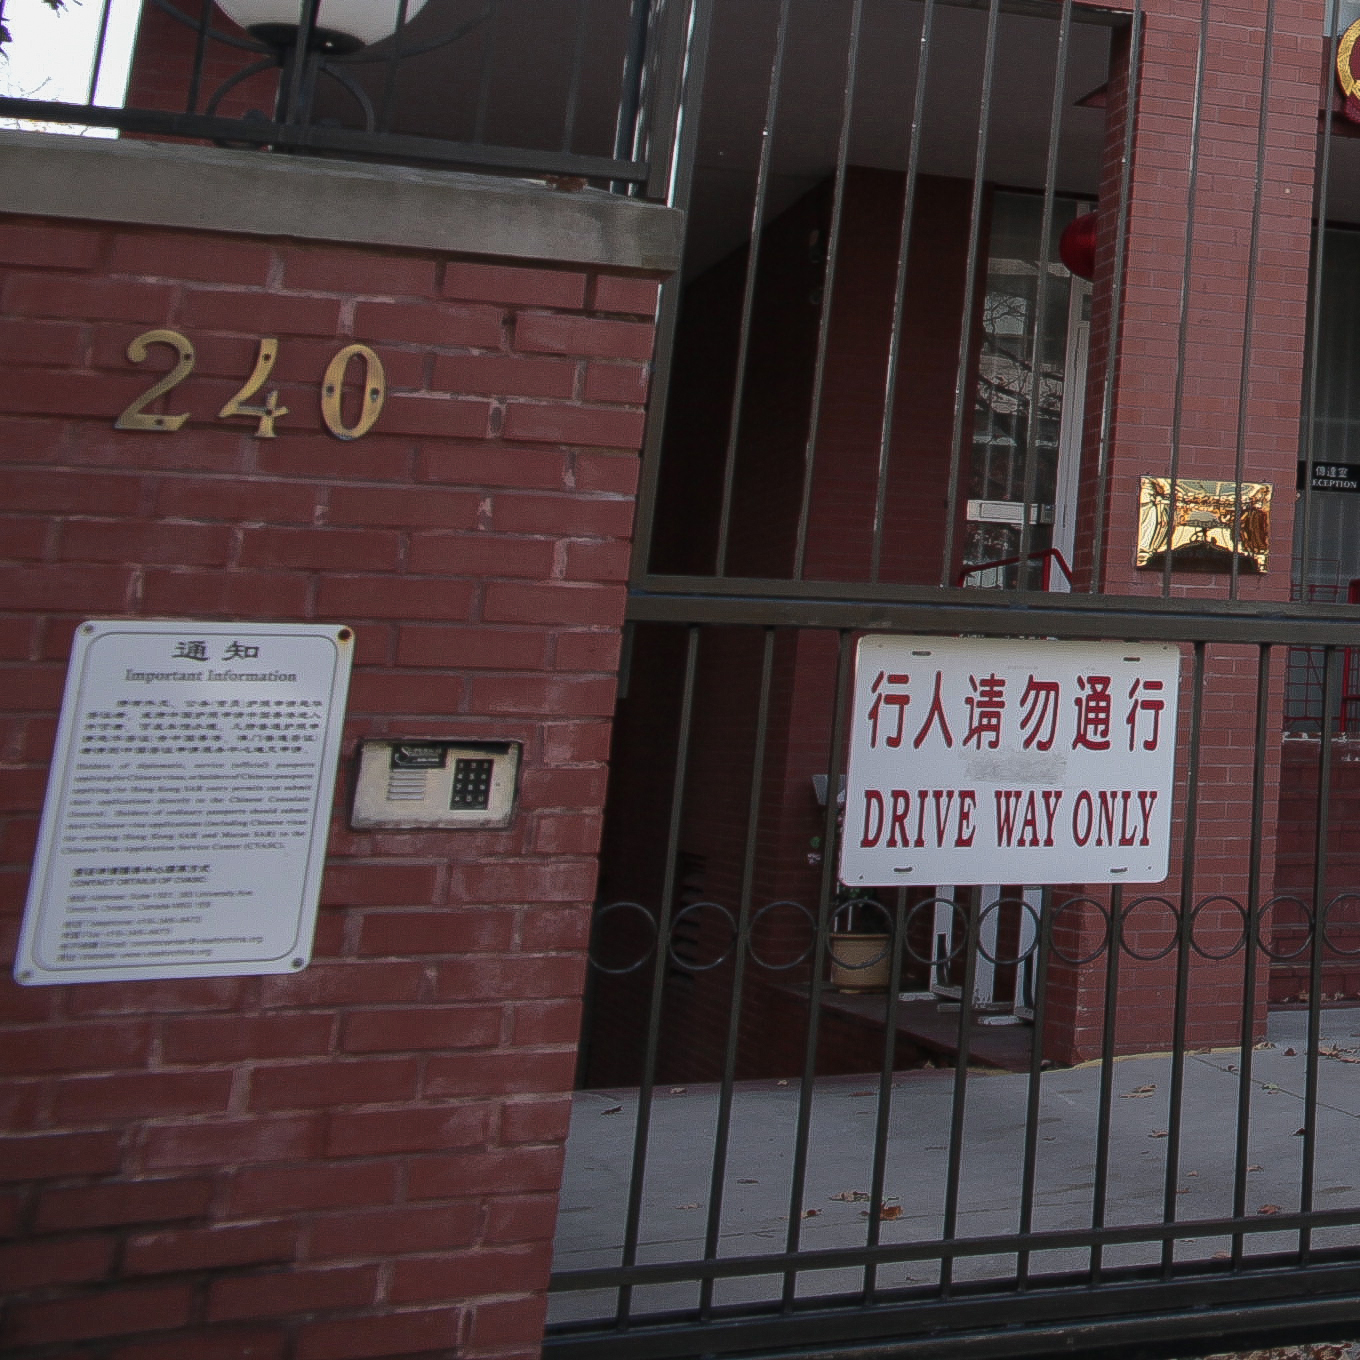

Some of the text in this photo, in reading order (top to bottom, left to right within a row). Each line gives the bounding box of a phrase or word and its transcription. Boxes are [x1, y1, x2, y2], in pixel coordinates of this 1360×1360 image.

[114, 329, 386, 440] 240
[1311, 479, 1358, 489] ECEPTION
[172, 640, 260, 661] 通知
[125, 668, 297, 684] Important Information
[867, 670, 1165, 752] 行人请勿通行
[859, 789, 1158, 848] DRIVE WAY ONLY
